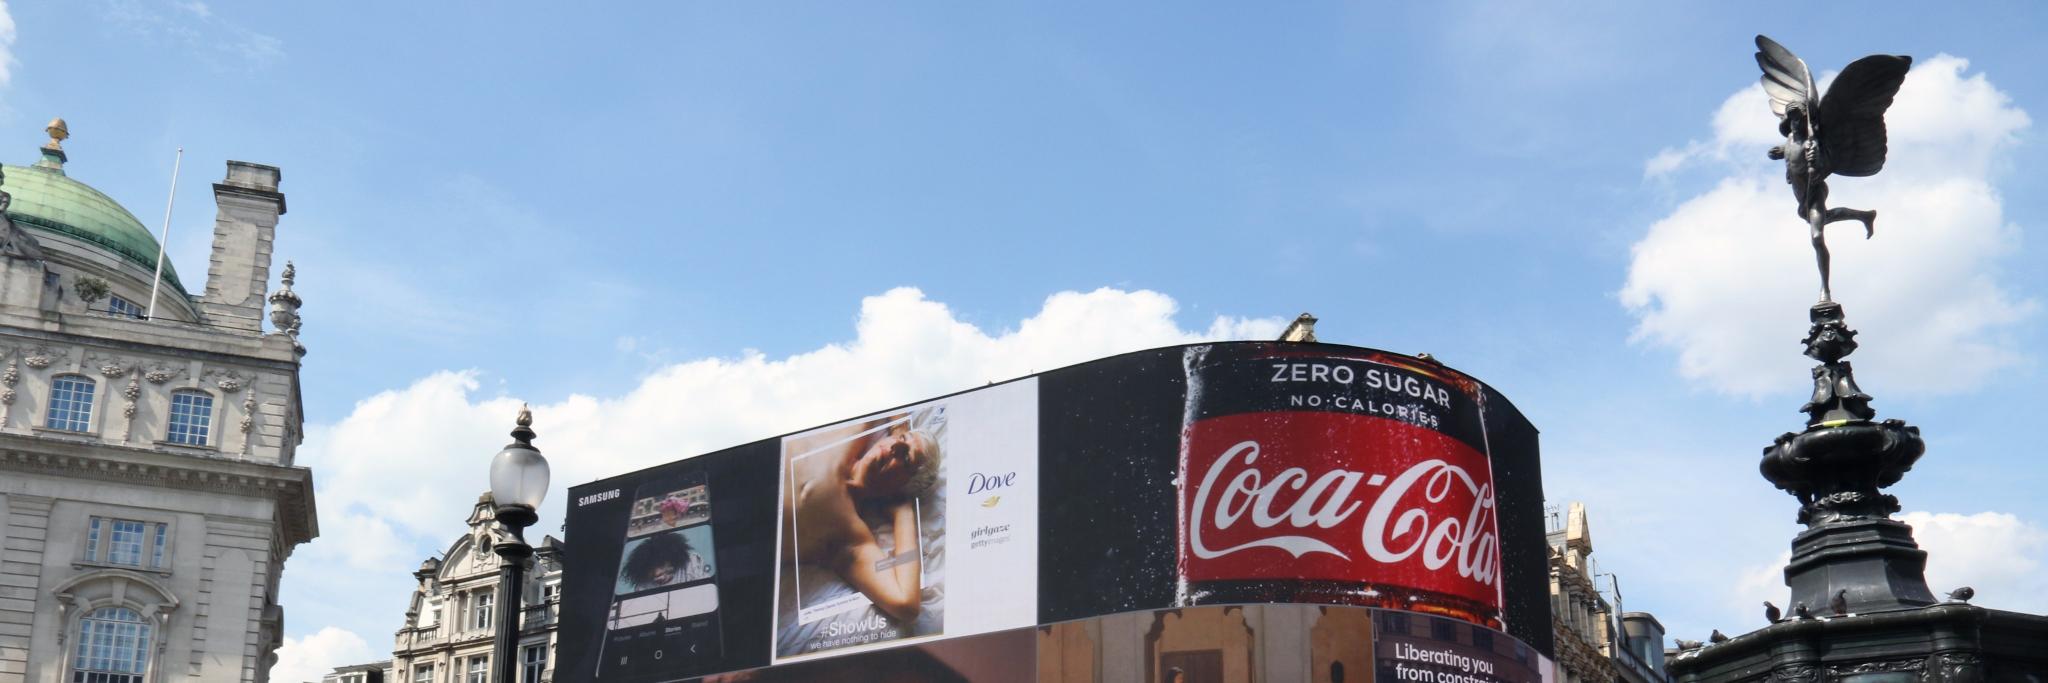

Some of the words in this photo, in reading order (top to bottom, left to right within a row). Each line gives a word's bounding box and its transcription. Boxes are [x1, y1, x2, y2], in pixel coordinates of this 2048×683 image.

[1271, 364, 1354, 384] ZERO
[1366, 369, 1451, 409] SUGAR
[1291, 395, 1321, 407] NO
[1335, 396, 1439, 427] CALORIES
[967, 471, 1016, 495] Dove
[578, 488, 620, 506] SAMSUNG
[1190, 440, 1497, 585] Coca-Cola
[971, 524, 1010, 540] girlgaze
[821, 614, 887, 638] #ShowUs
[810, 641, 822, 650] we
[823, 638, 840, 648] have
[841, 633, 869, 645] nothing
[870, 632, 879, 641] to
[880, 629, 897, 639] hide
[1395, 643, 1470, 672] Liberating
[1471, 657, 1494, 674] you
[1395, 663, 1434, 683] from
